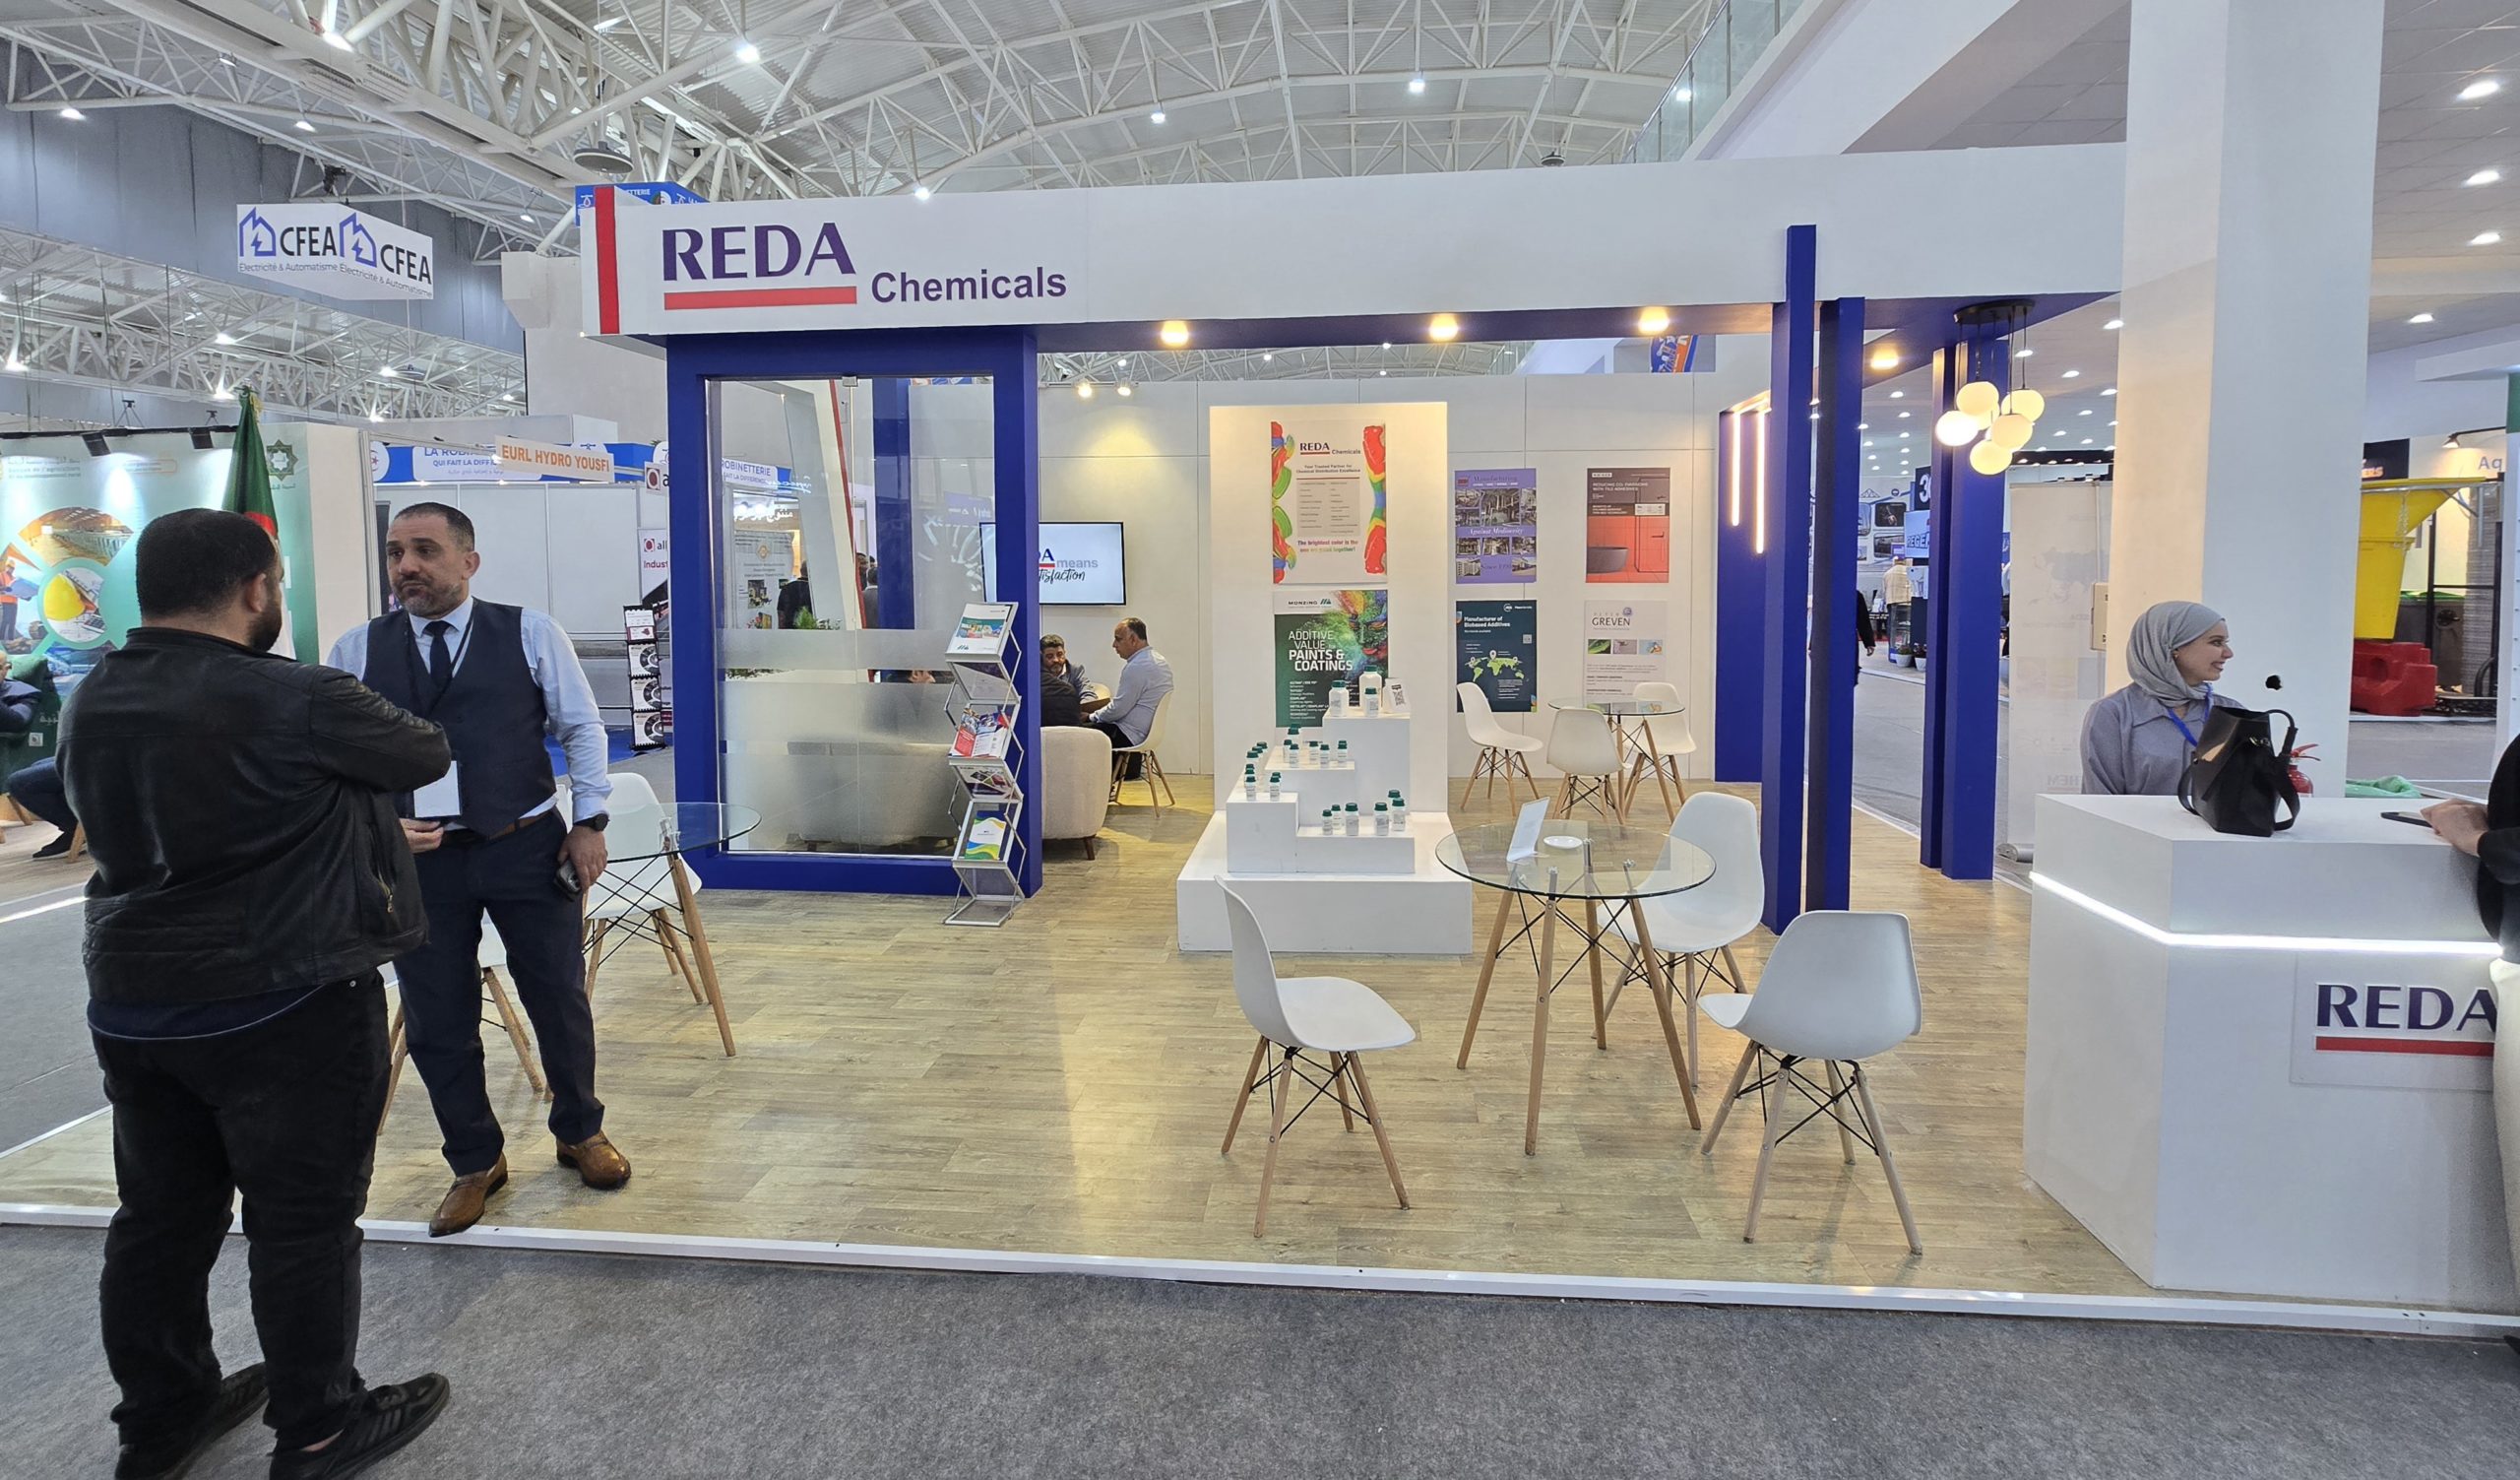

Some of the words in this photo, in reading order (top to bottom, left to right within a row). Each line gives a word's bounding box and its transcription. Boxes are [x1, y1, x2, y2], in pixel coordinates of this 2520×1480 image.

[280, 226, 338, 257] CFEA
[662, 222, 856, 282] REDA
[380, 244, 432, 285] CFEA
[386, 279, 432, 296] Automatisme
[871, 267, 1067, 303] Chemicals
[1299, 442, 1330, 451] REDA
[502, 444, 532, 462] EURL
[535, 449, 571, 467] HYDRO
[574, 456, 609, 472] YOUSFI
[1920, 474, 1931, 503] 3
[1056, 559, 1099, 568] means
[1592, 617, 1630, 626] GREVEN
[1289, 630, 1335, 640] ADDITIVE
[1294, 640, 1326, 650] VALUE
[1289, 649, 1332, 660] PAINTS
[1336, 649, 1345, 660] &
[1294, 661, 1353, 671] COATINGS
[2316, 984, 2497, 1033] REDA
